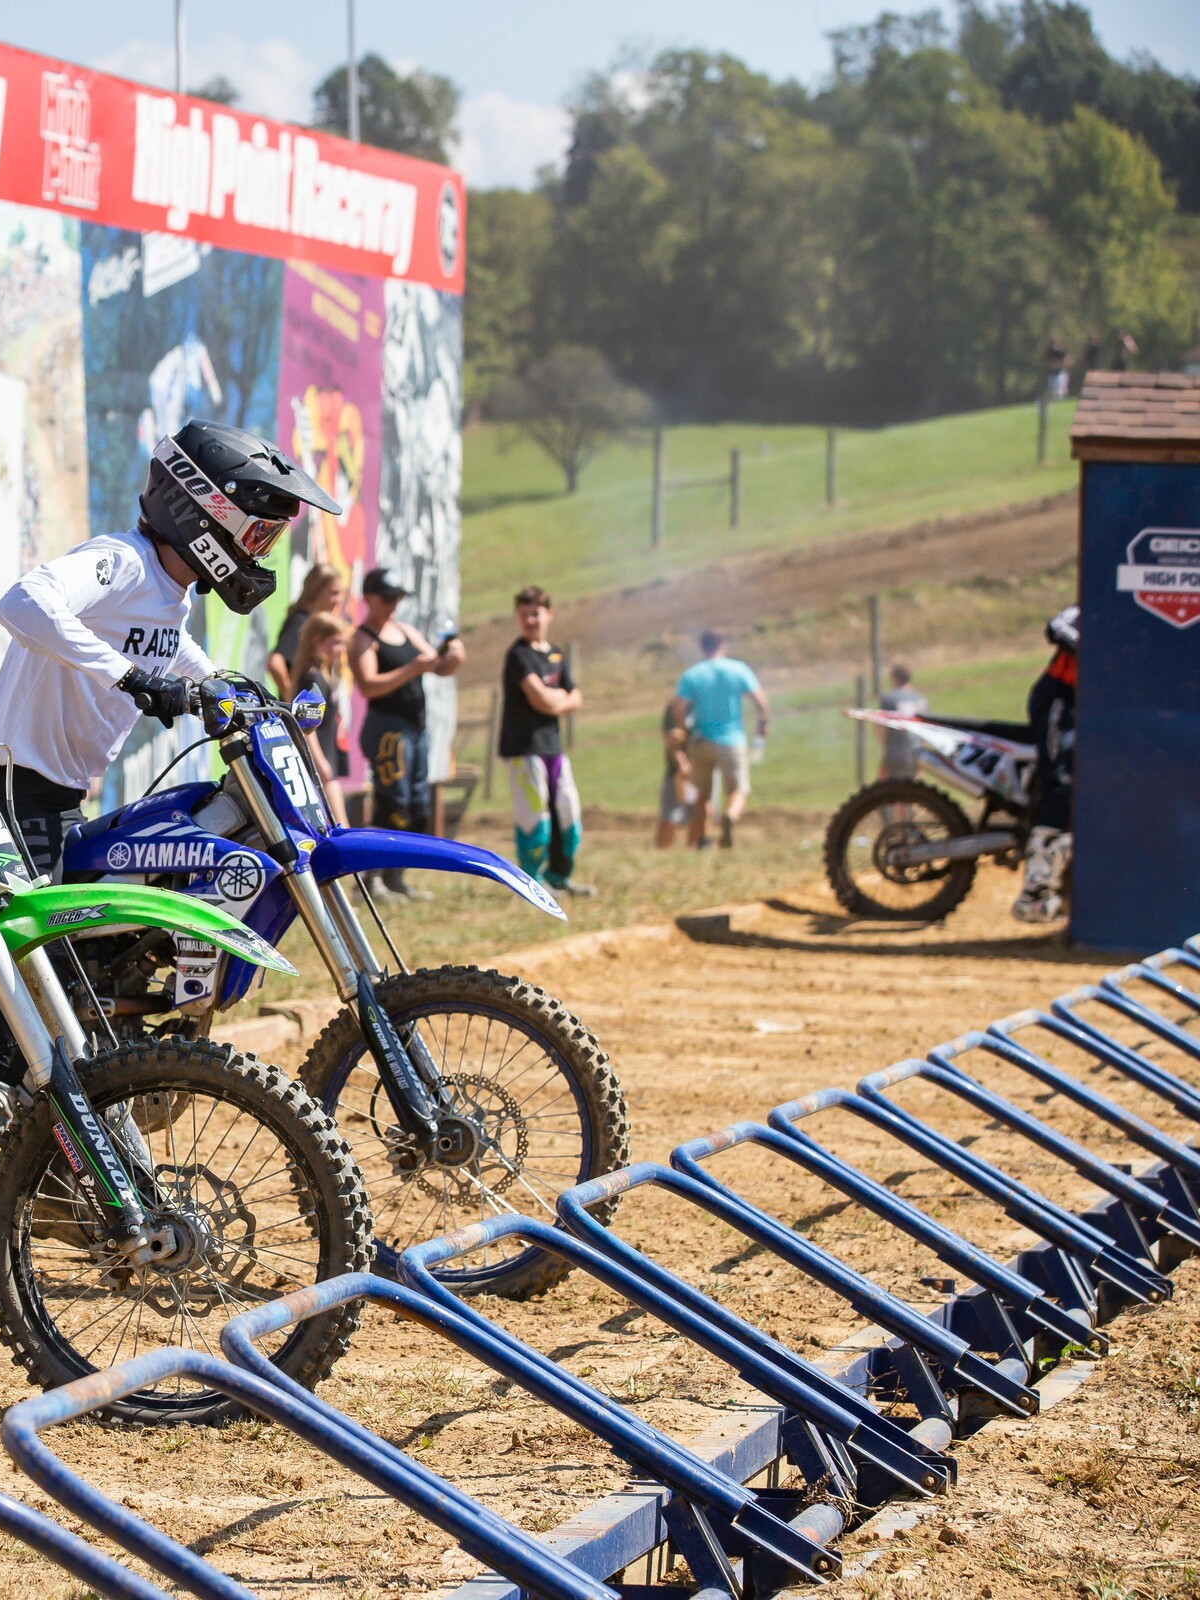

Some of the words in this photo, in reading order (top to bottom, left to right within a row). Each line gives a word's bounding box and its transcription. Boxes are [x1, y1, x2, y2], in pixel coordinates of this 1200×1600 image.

[132, 92, 211, 231] High
[209, 112, 292, 234] Point
[290, 134, 417, 277] Raceway
[163, 450, 238, 521] 100%
[193, 538, 230, 578] 310
[1143, 571, 1177, 586] HIGH
[122, 627, 180, 659] RACER
[133, 842, 216, 868] YAMAHA
[179, 939, 215, 954] YAMALUBE
[372, 1022, 390, 1050] CYCRA
[55, 1122, 84, 1169] PARTS
